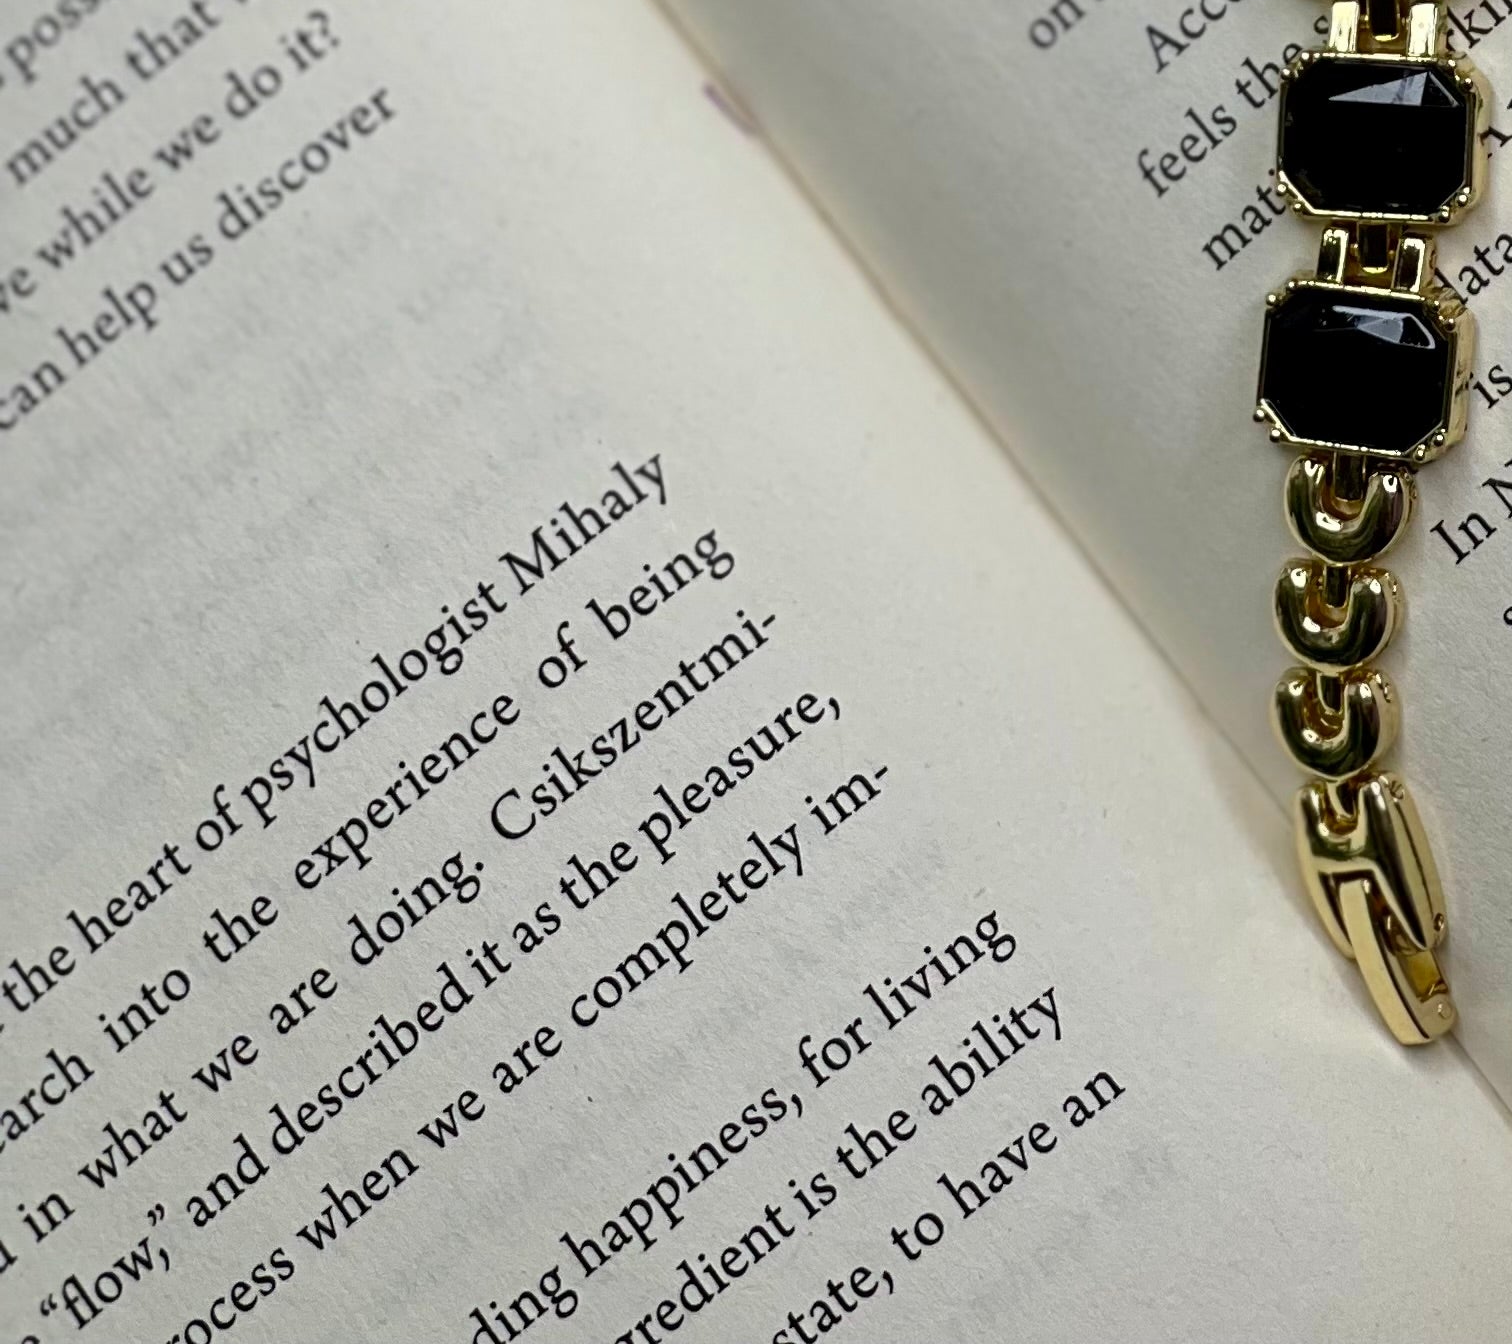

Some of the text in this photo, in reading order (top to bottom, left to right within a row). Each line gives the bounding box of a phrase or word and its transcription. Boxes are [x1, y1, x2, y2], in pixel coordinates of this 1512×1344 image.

[5, 75, 127, 186] much
[125, 0, 220, 81] that
[35, 9, 340, 269] while we do it?
[55, 281, 158, 368] help
[159, 234, 214, 286] us
[218, 88, 395, 240] discover
[1138, 104, 1237, 197] feels
[1430, 512, 1497, 564] In
[1, 454, 667, 1012] the heart of psychologist Mihaly
[98, 530, 735, 1052] into the experience of being
[17, 610, 776, 1242] in what we are doing. Csikszentmi-
[186, 1133, 270, 1227] and
[269, 964, 474, 1155] described
[465, 941, 512, 988] it
[512, 901, 561, 953] as
[560, 841, 638, 909] the
[638, 693, 840, 865] pleasure,
[296, 766, 888, 1250] when we are completely im-
[560, 910, 1016, 1277] happiness, for living
[788, 987, 1062, 1219] is the ability
[891, 1071, 1126, 1260] to have an
